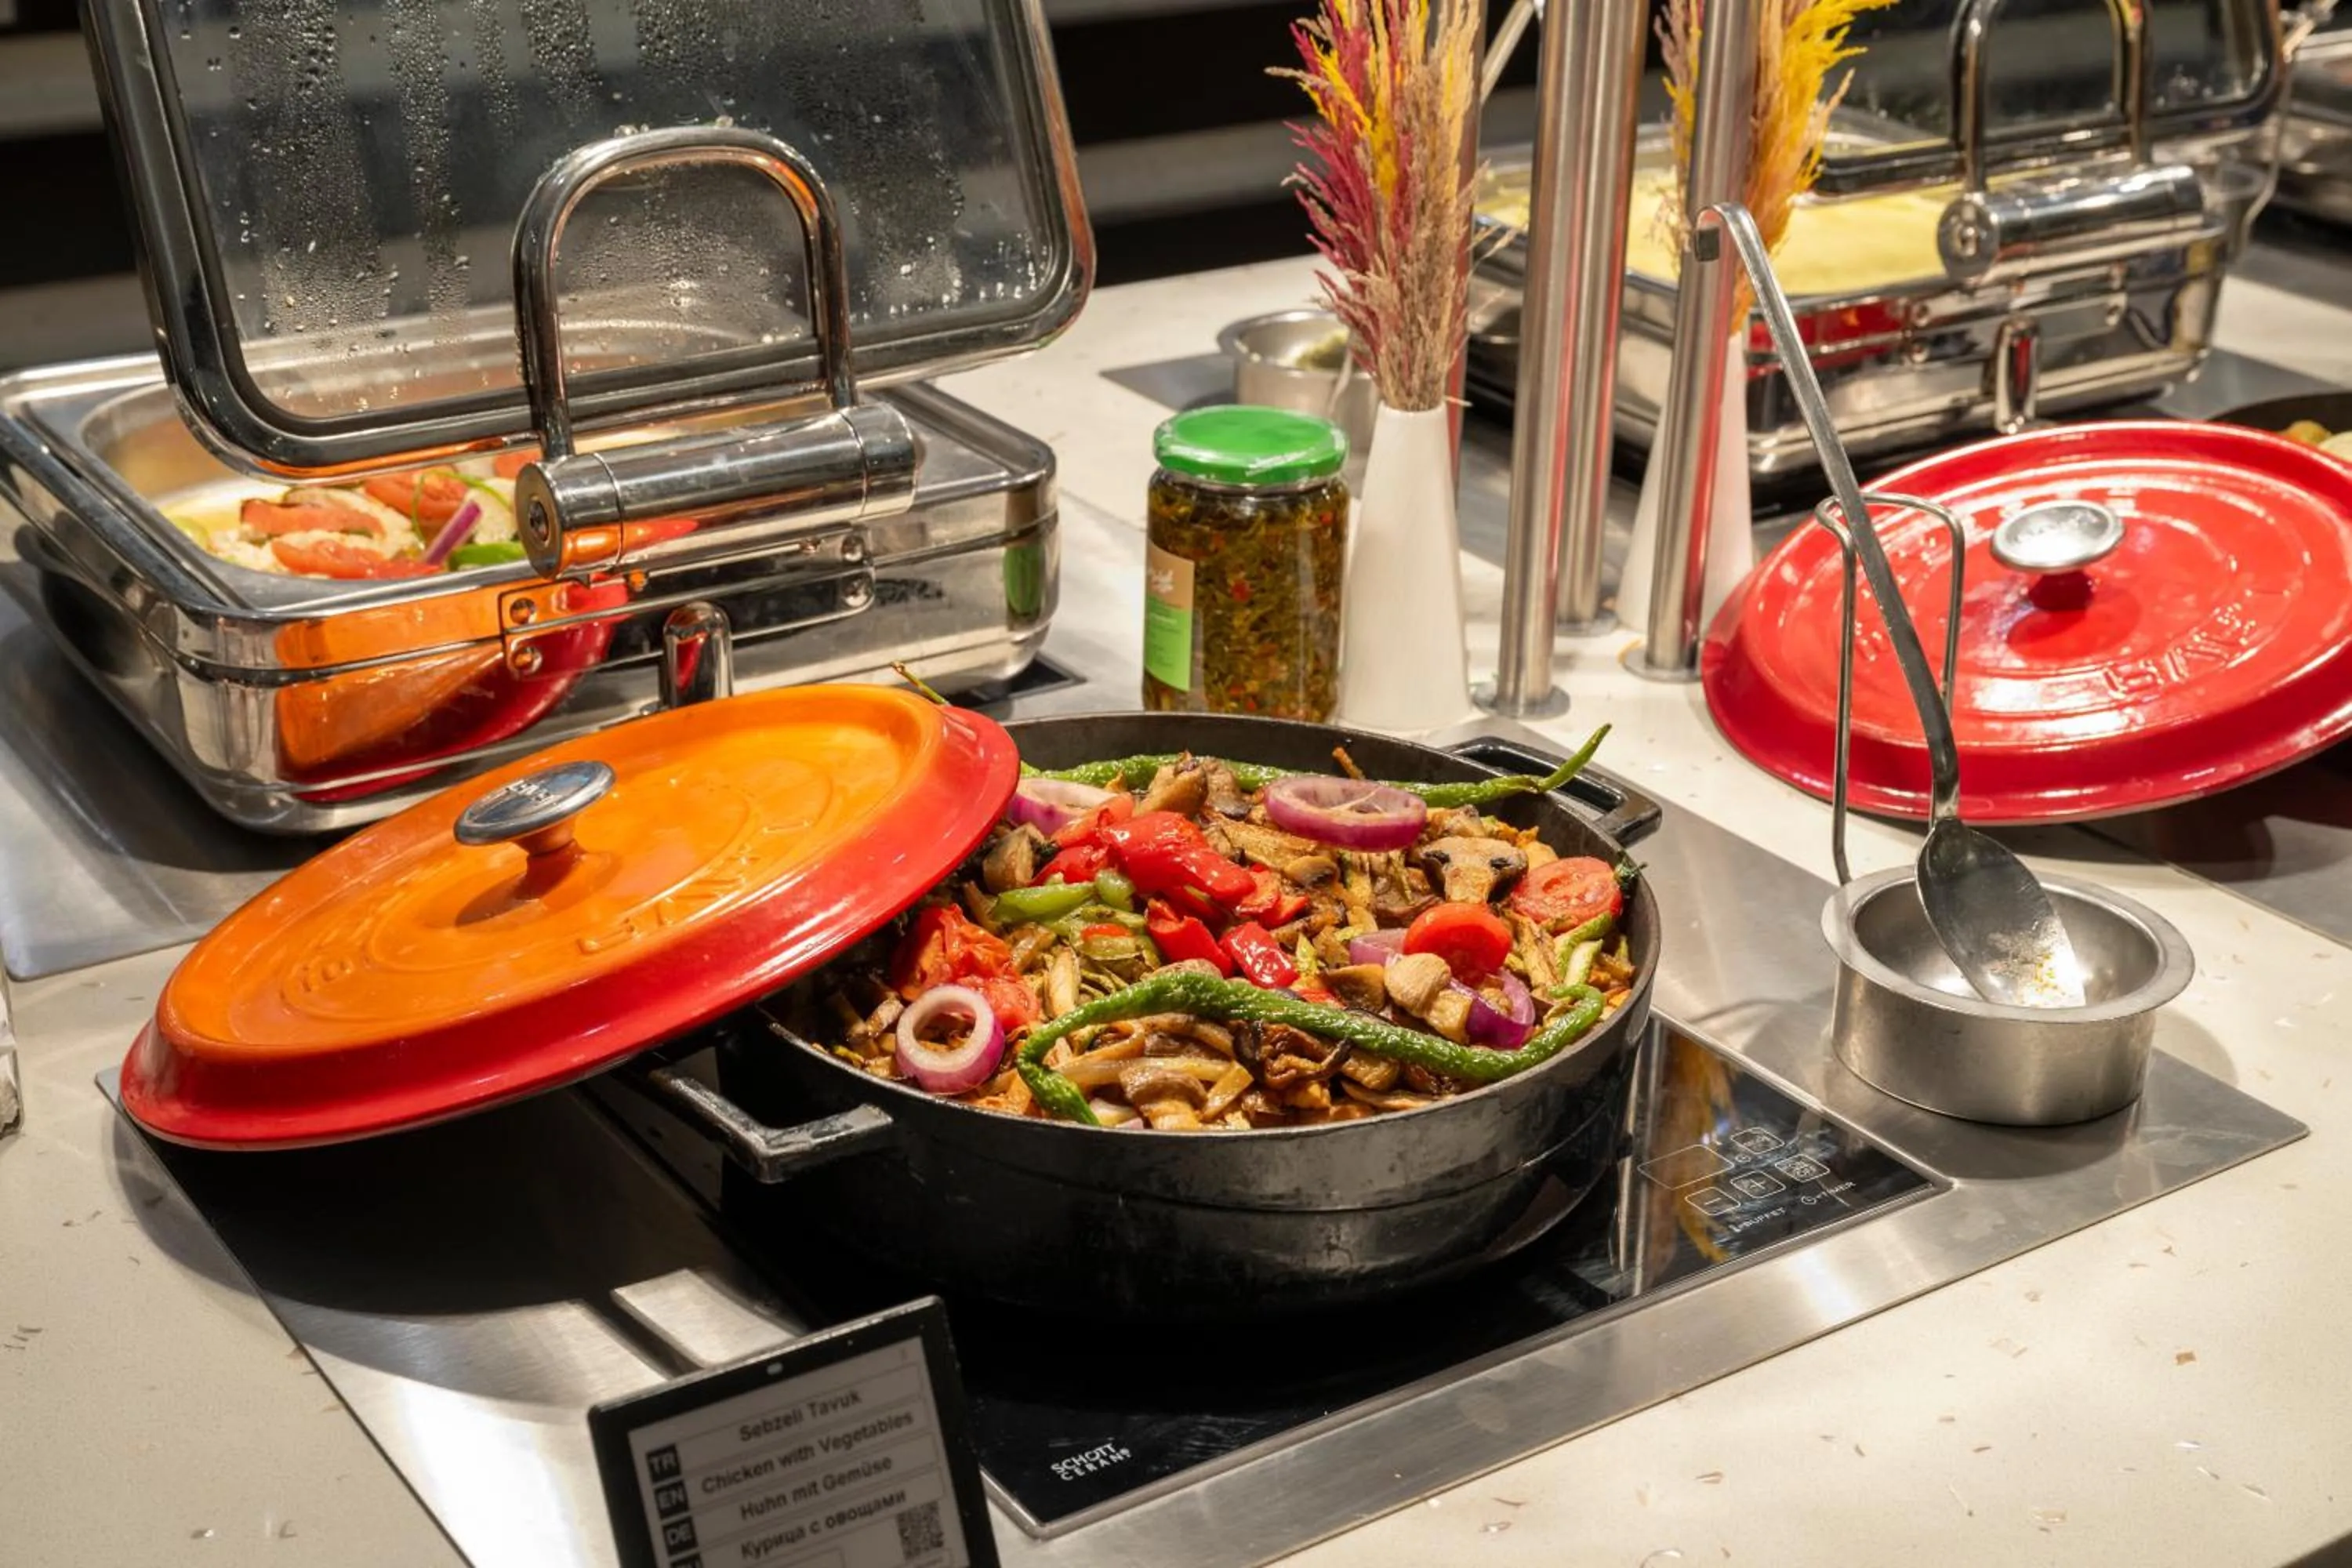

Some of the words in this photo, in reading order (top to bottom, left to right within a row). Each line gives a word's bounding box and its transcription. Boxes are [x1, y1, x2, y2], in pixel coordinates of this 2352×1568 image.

[739, 1407, 804, 1442] Sebzeli
[806, 1389, 862, 1417] Tavuk
[649, 1452, 677, 1475] TR
[701, 1457, 775, 1494] Chicken
[777, 1444, 815, 1468] with
[818, 1410, 915, 1454] Vegetables
[1051, 1443, 1117, 1475] SCHOTT
[658, 1485, 685, 1510] EN
[739, 1492, 789, 1521] Huhn
[790, 1479, 820, 1503] mit
[822, 1456, 894, 1491] Gemüse
[666, 1522, 692, 1547] DE
[740, 1525, 807, 1560] Курица
[809, 1520, 822, 1534] с
[825, 1488, 907, 1530] овощами
